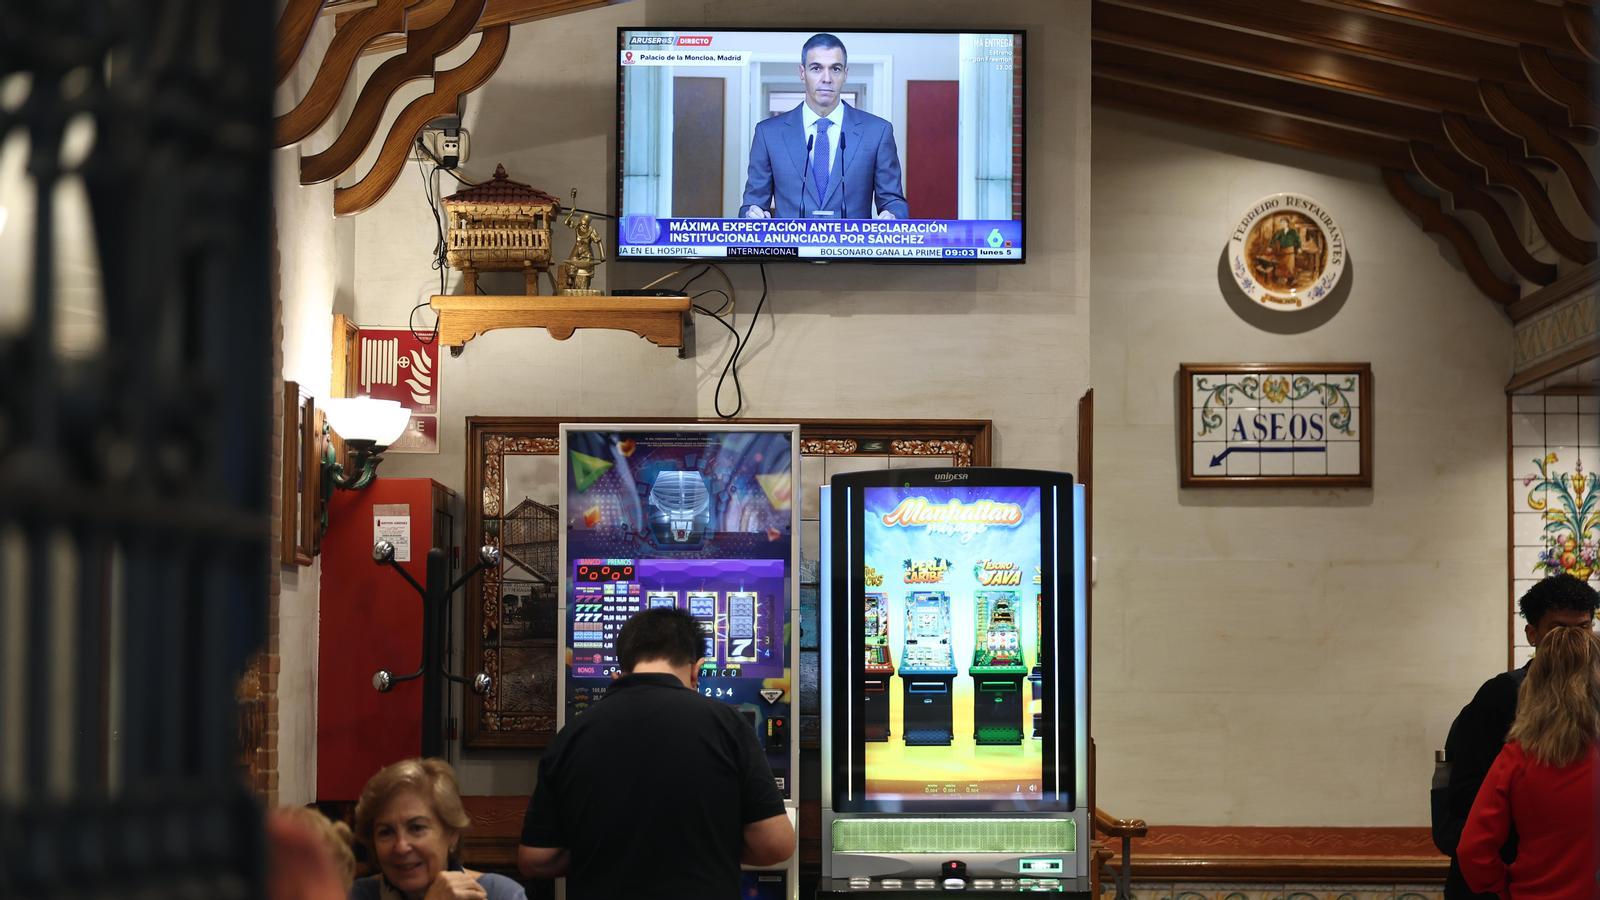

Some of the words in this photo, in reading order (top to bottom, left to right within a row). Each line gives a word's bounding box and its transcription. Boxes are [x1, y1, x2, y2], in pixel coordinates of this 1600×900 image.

[984, 38, 1013, 48] ENTREGA
[670, 220, 720, 232] MÁXIMA
[723, 220, 806, 232] EXPECTACIÓN
[809, 223, 840, 232] ANTE
[844, 223, 860, 232] LA
[862, 222, 948, 233] DECLARACIÓN
[1232, 200, 1279, 242] FERREIRO
[1286, 196, 1342, 265] RESTAURANTES
[670, 233, 760, 242] INSTITUCIONAL
[764, 234, 836, 243] ANUNCIADA
[840, 234, 865, 243] POR
[868, 232, 924, 244] SÁNCHEZ
[1232, 412, 1324, 441] ASEOS
[884, 498, 1022, 525] Manhattan
[911, 558, 948, 572] PERLA
[904, 570, 945, 584] CARIBE
[982, 570, 1022, 586] JAVA
[576, 604, 602, 612] 777
[575, 613, 602, 622] 777
[765, 636, 770, 644] 3
[731, 639, 752, 656] 7
[705, 688, 711, 696] 2
[716, 688, 722, 696] 3
[726, 688, 733, 696] 4
